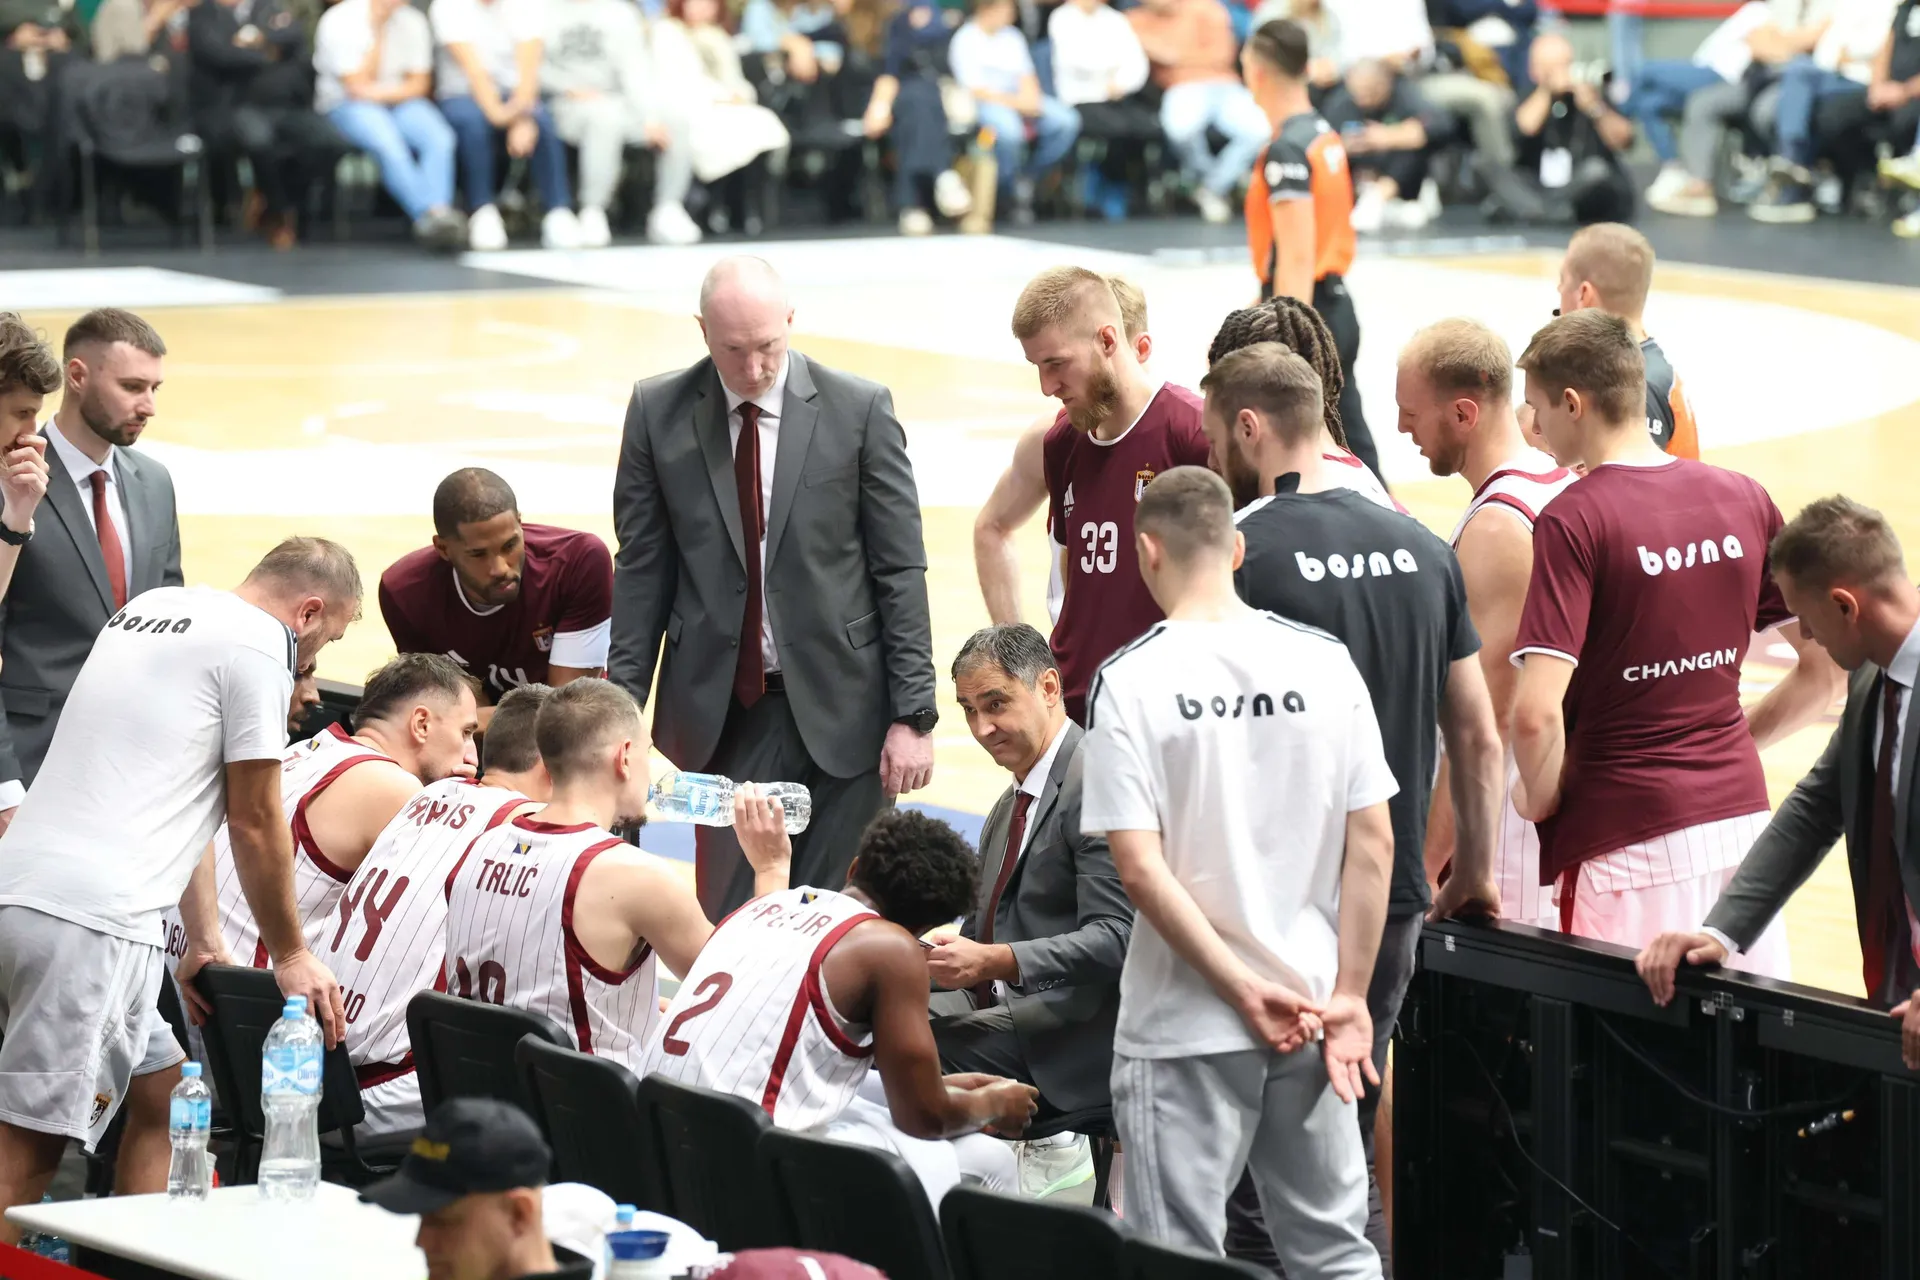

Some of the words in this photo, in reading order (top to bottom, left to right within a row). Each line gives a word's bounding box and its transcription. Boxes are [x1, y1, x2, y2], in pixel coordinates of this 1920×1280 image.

[1080, 521, 1119, 574] 33
[1294, 548, 1418, 582] bosna
[1637, 535, 1744, 576] bosna
[107, 607, 192, 634] bosna
[1623, 647, 1738, 682] CHANGAN
[1175, 690, 1306, 720] bosna
[476, 858, 540, 898] TALIĆ
[662, 971, 733, 1057] 2
